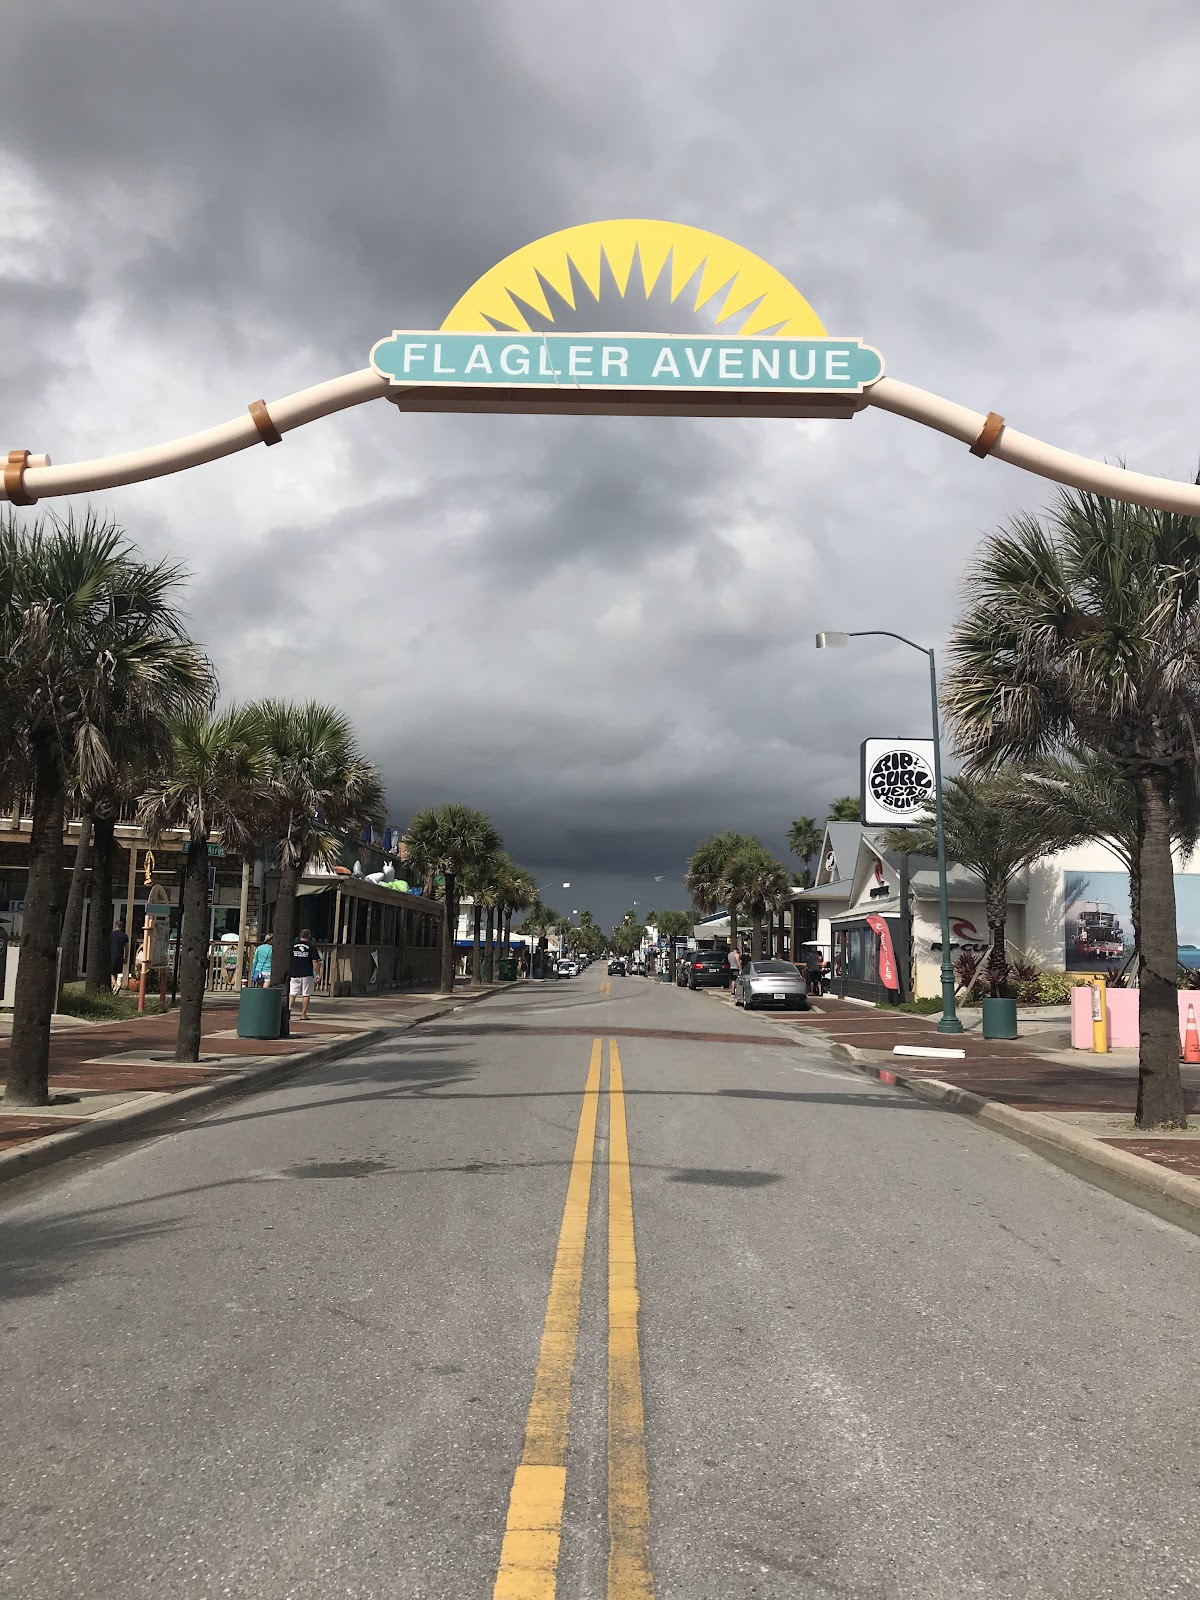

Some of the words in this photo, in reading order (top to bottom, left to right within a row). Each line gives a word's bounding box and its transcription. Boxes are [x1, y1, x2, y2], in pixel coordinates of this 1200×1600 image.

[403, 343, 629, 377] FLAGLER
[651, 347, 850, 380] AVENUE
[873, 752, 913, 773] RIP
[871, 770, 932, 789] CURL
[880, 931, 892, 980] RENTALS
[930, 942, 960, 951] RP
